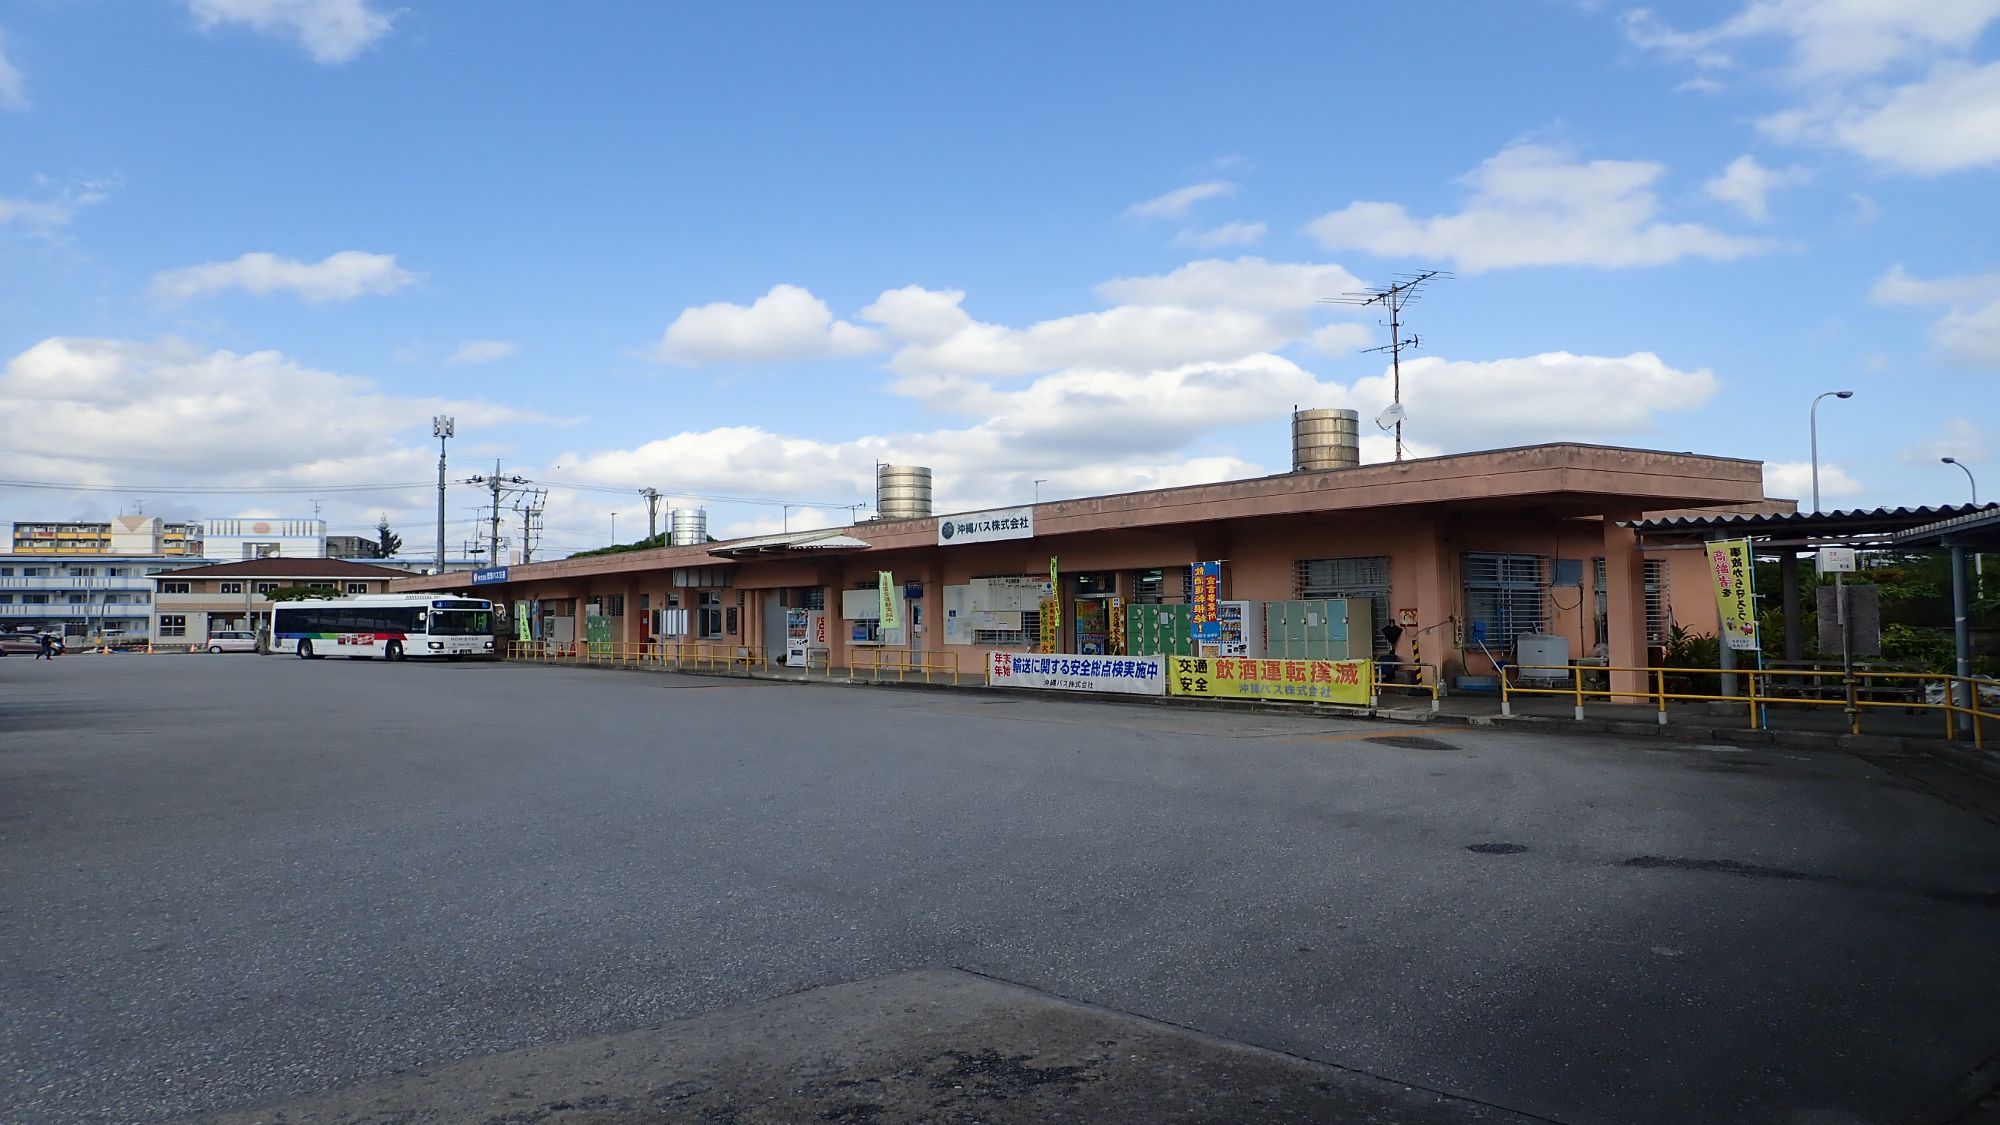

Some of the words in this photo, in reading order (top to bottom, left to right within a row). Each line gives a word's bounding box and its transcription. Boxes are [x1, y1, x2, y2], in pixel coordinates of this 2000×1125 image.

[957, 516, 1029, 535] 沖縄バス株式会社
[994, 653, 1011, 664] 年末
[994, 666, 1011, 677] 年始
[1012, 657, 1158, 680] 輸送に関する安全総点検実施中
[1178, 659, 1208, 674] 交通
[1216, 659, 1360, 685] 飲酒運転撲滅
[1043, 679, 1094, 689] 沖縄バス株式会社
[1179, 677, 1208, 693] 安全
[1238, 683, 1333, 698] 沖縄バス株式会社
